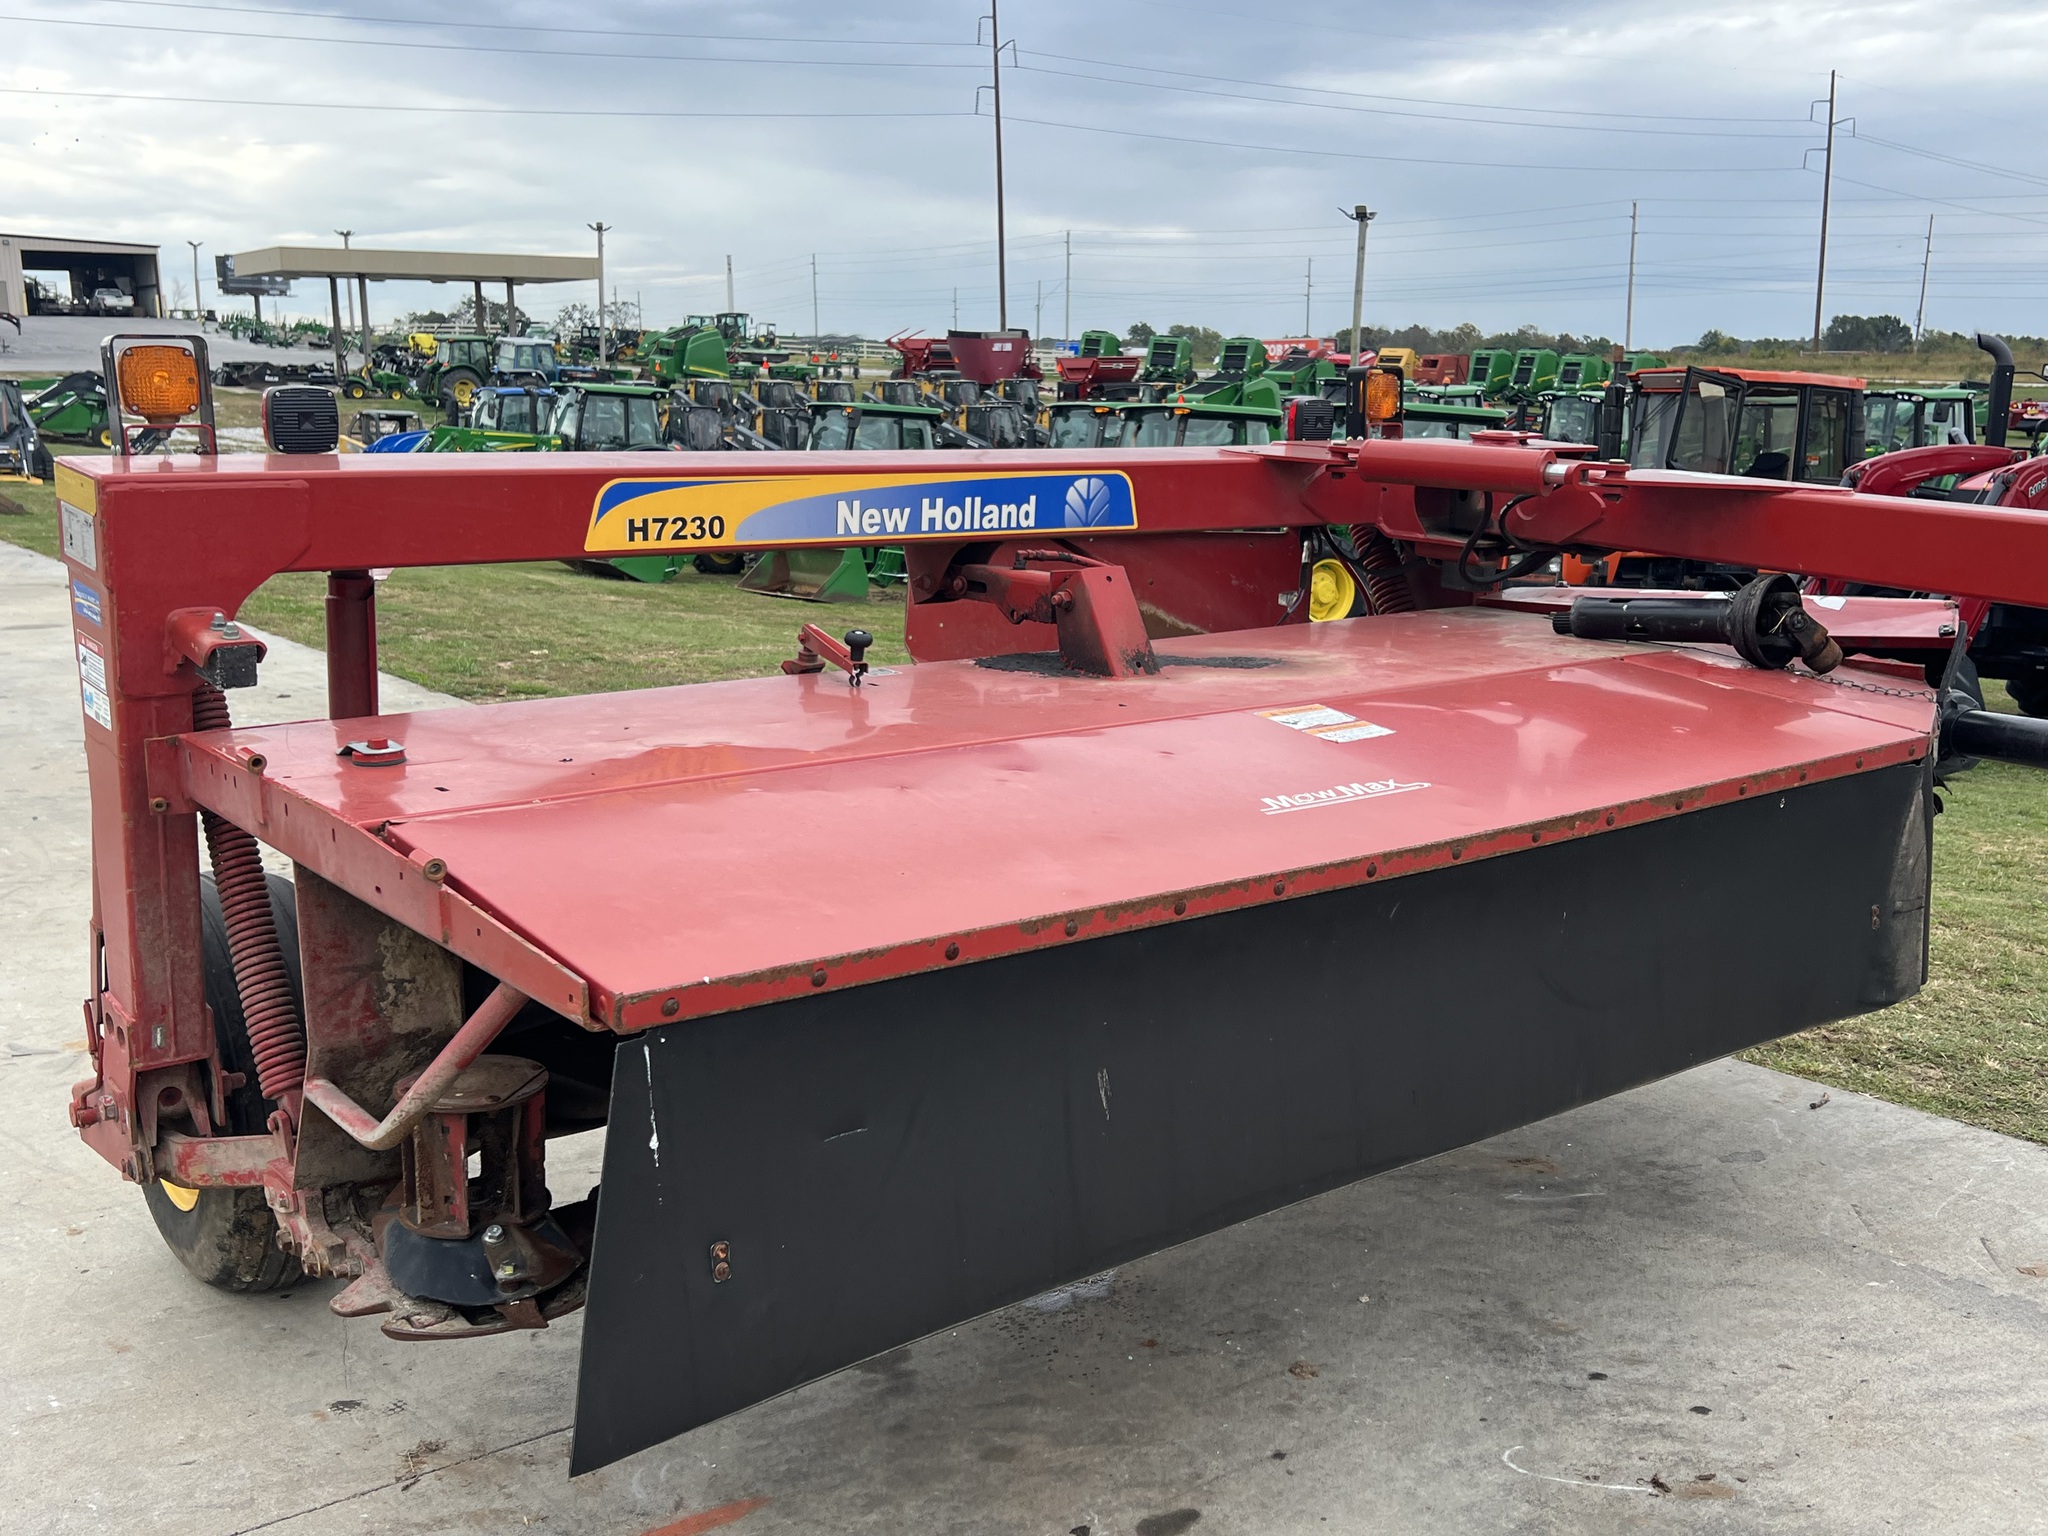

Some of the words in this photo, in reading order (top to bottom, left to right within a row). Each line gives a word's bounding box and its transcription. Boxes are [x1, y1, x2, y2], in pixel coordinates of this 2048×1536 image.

[627, 515, 726, 543] H7230
[836, 499, 911, 535] New
[920, 494, 1037, 532] Holland
